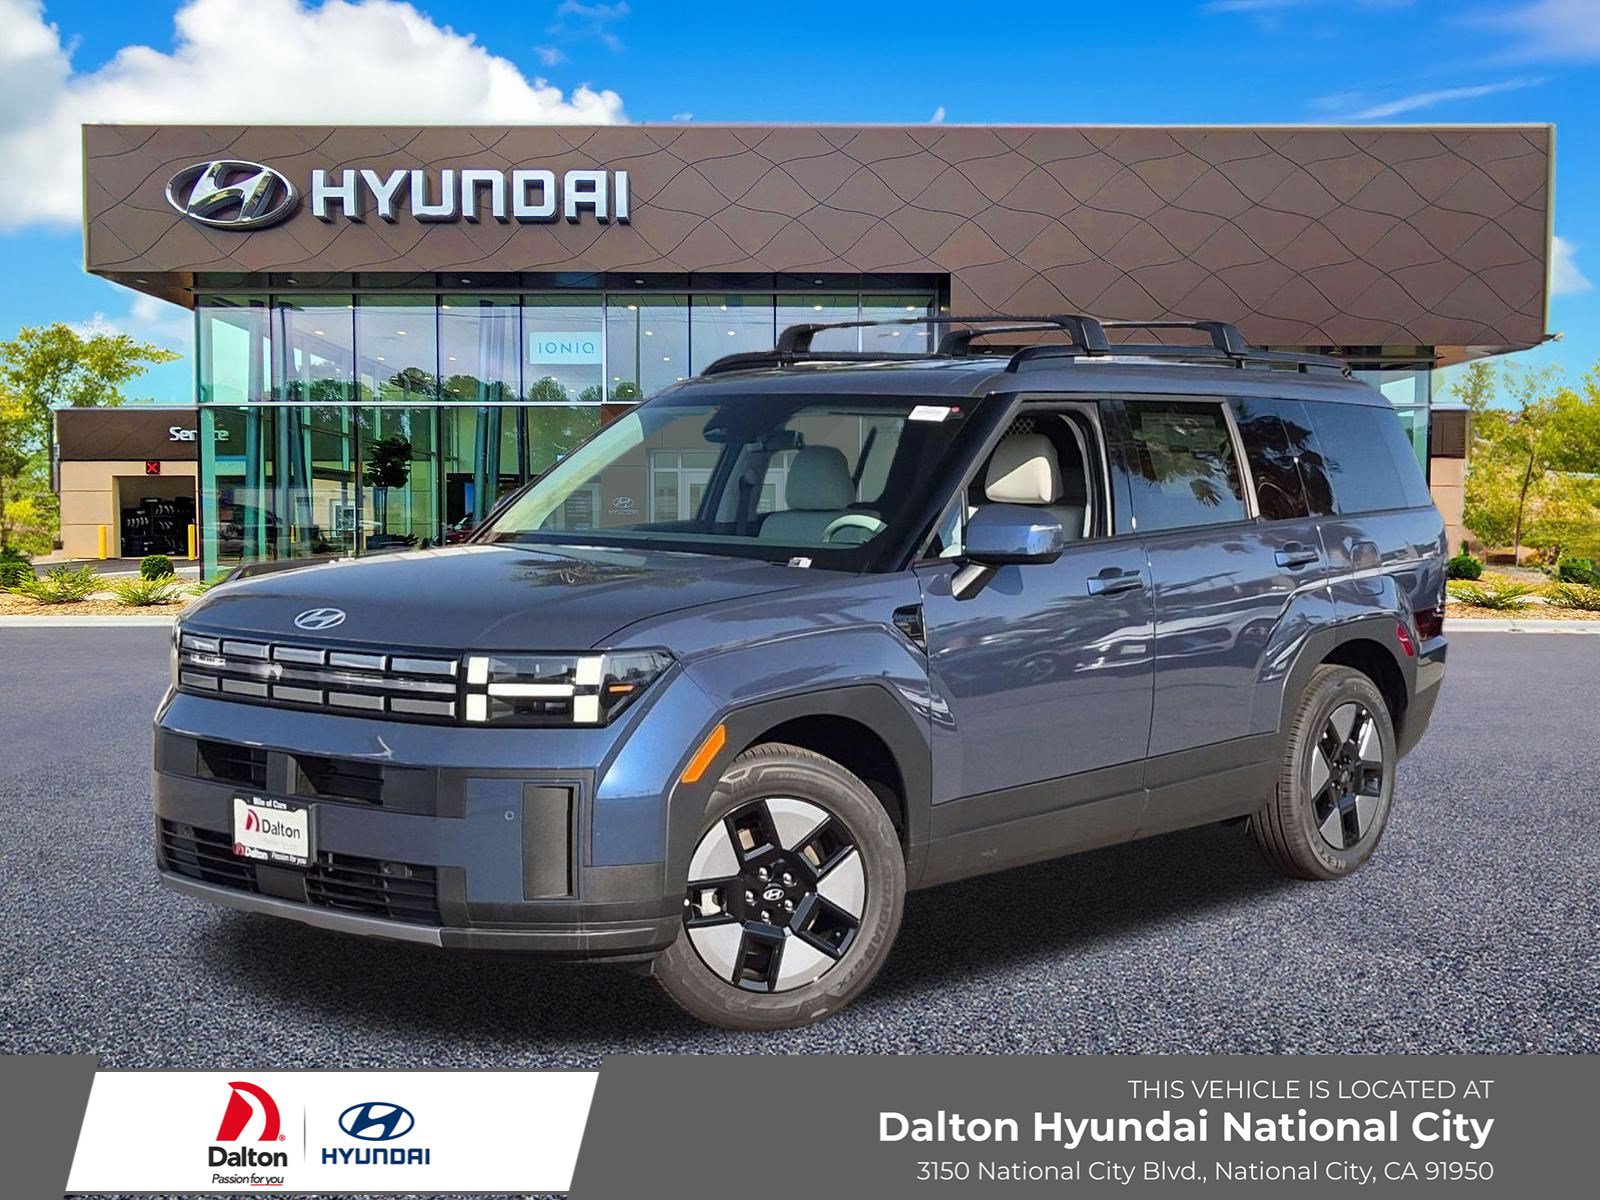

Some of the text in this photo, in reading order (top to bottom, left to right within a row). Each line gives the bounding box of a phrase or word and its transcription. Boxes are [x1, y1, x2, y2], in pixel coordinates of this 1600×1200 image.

[311, 168, 631, 223] HYUNDAI
[538, 341, 595, 354] IONIQ
[169, 426, 230, 441] Sere
[262, 819, 301, 839] Dalton
